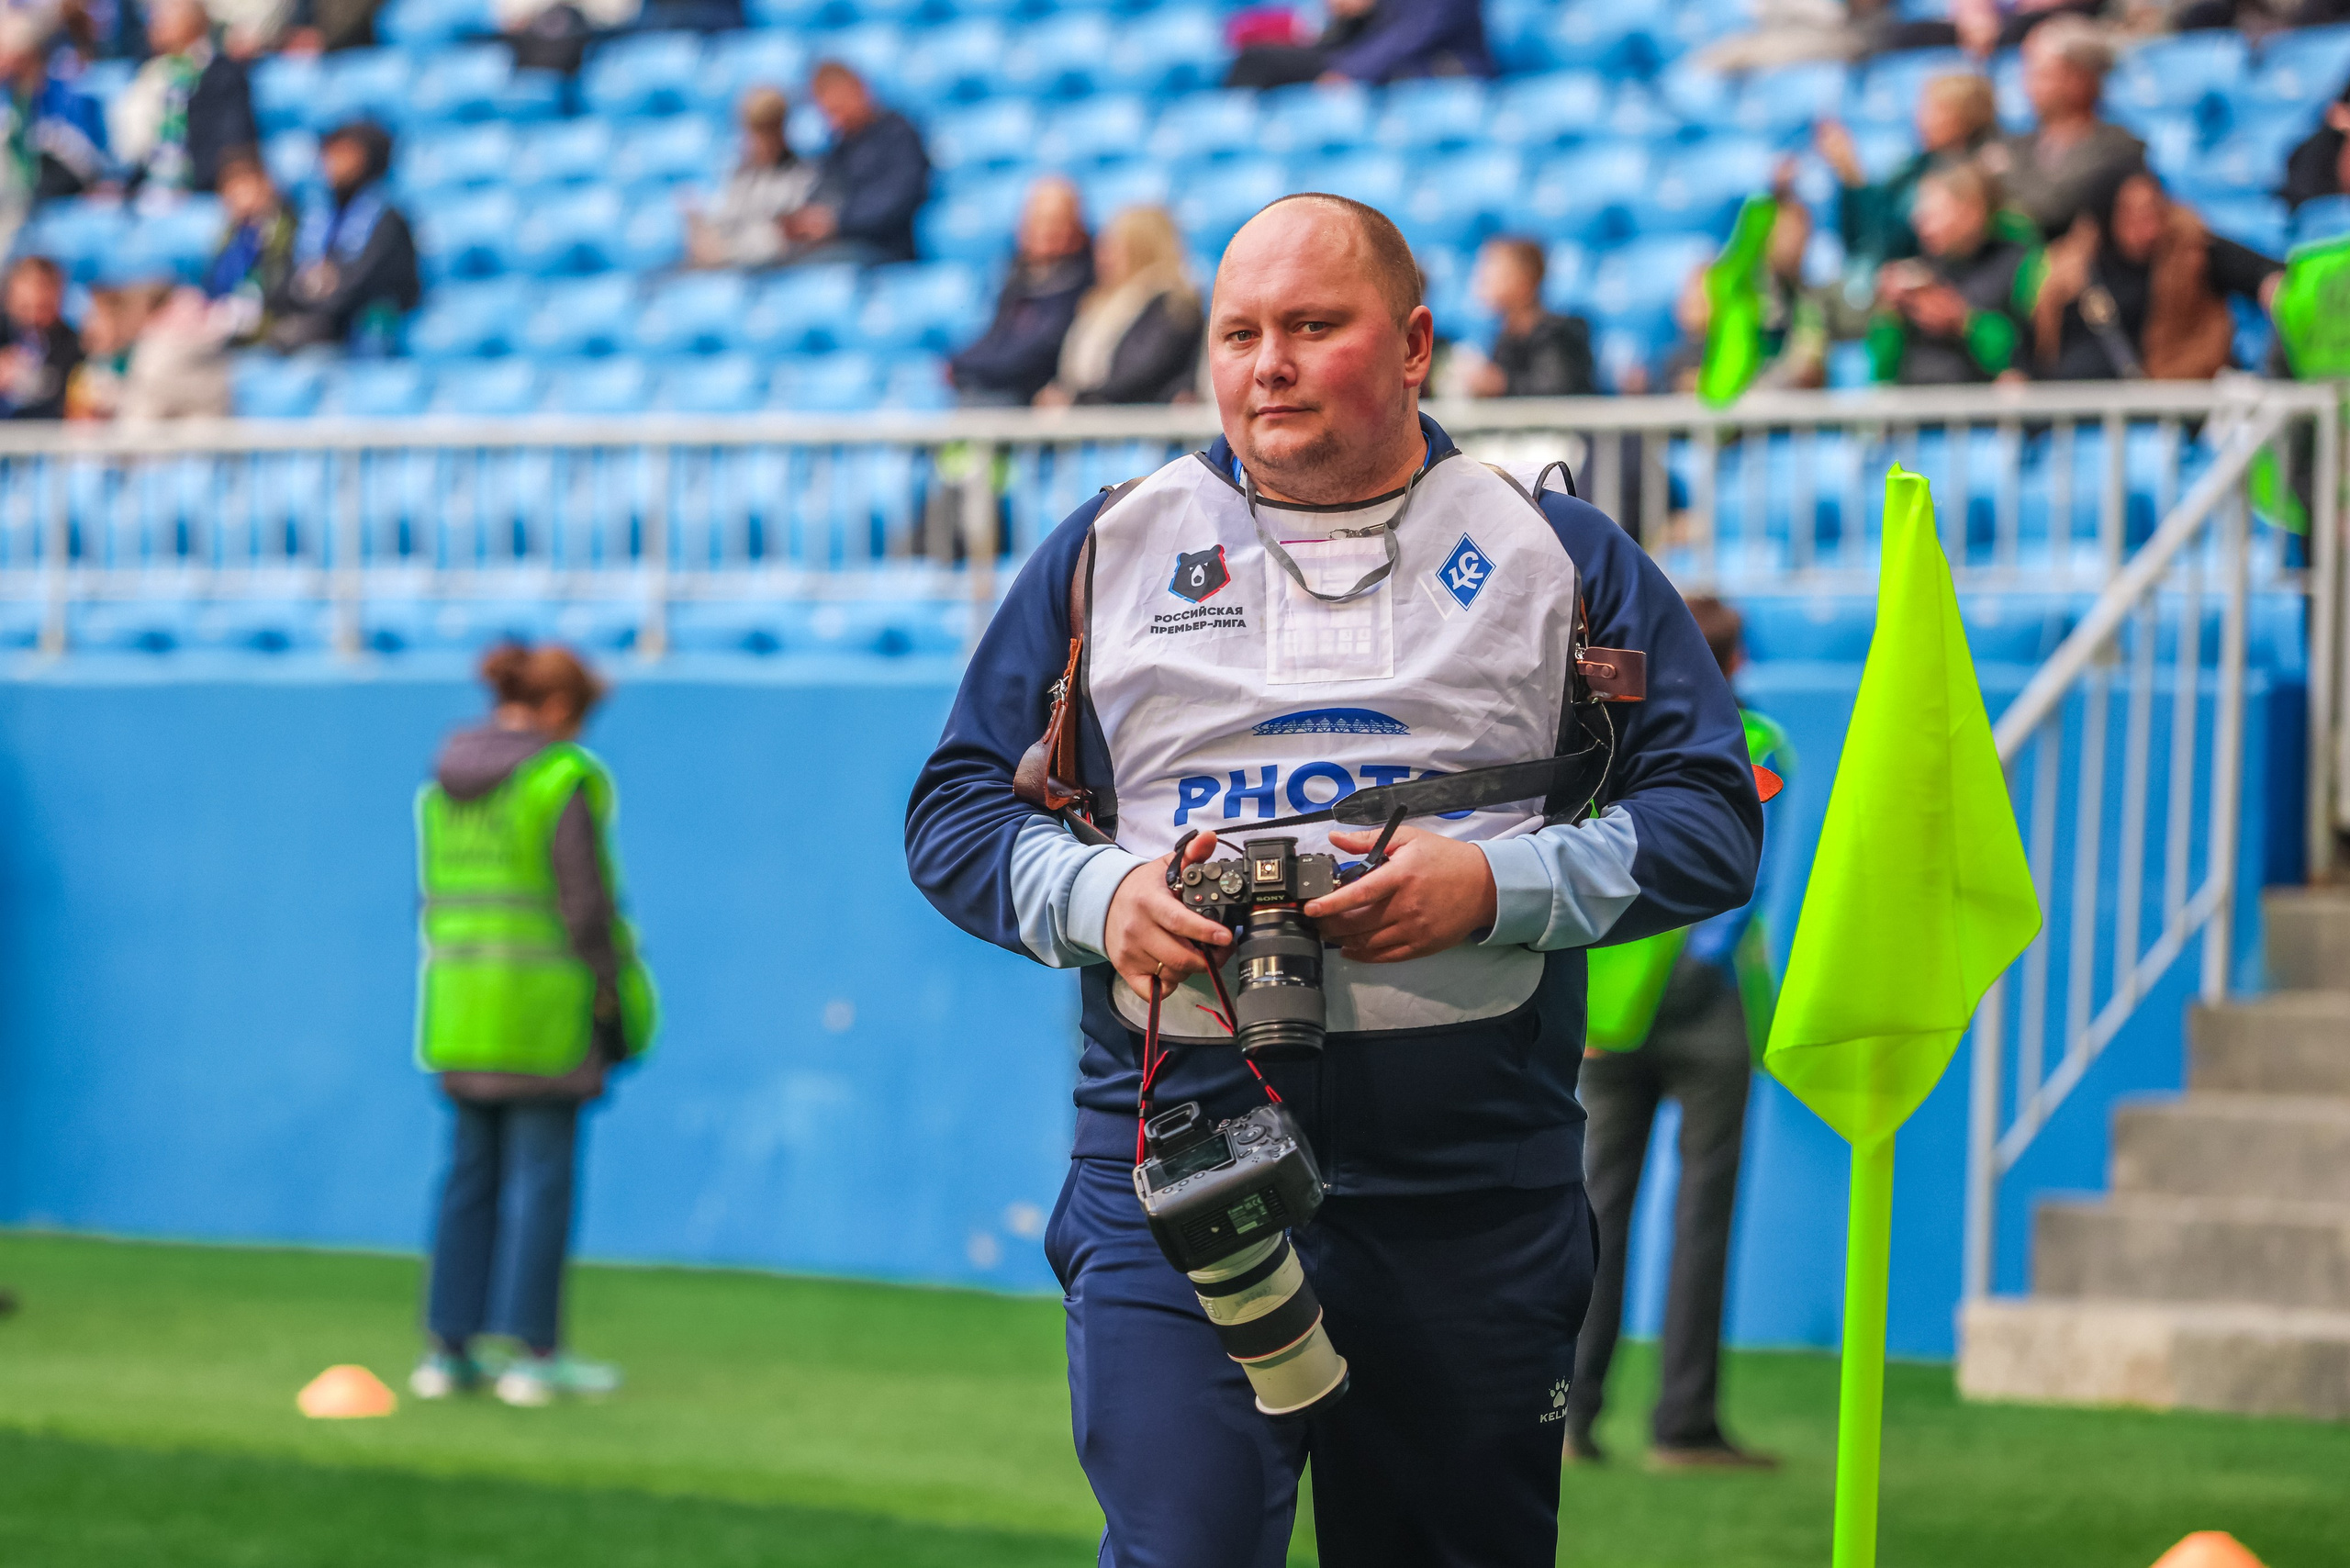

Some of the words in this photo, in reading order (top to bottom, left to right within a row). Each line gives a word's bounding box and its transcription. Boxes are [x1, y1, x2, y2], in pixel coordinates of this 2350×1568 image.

[1154, 606, 1244, 623] РОССИЙСКАЯ
[1150, 619, 1248, 634] ПРЕМЬЕР-ЛИГА
[1174, 761, 1477, 827] PHOT
[1539, 1404, 1569, 1424] KELM
